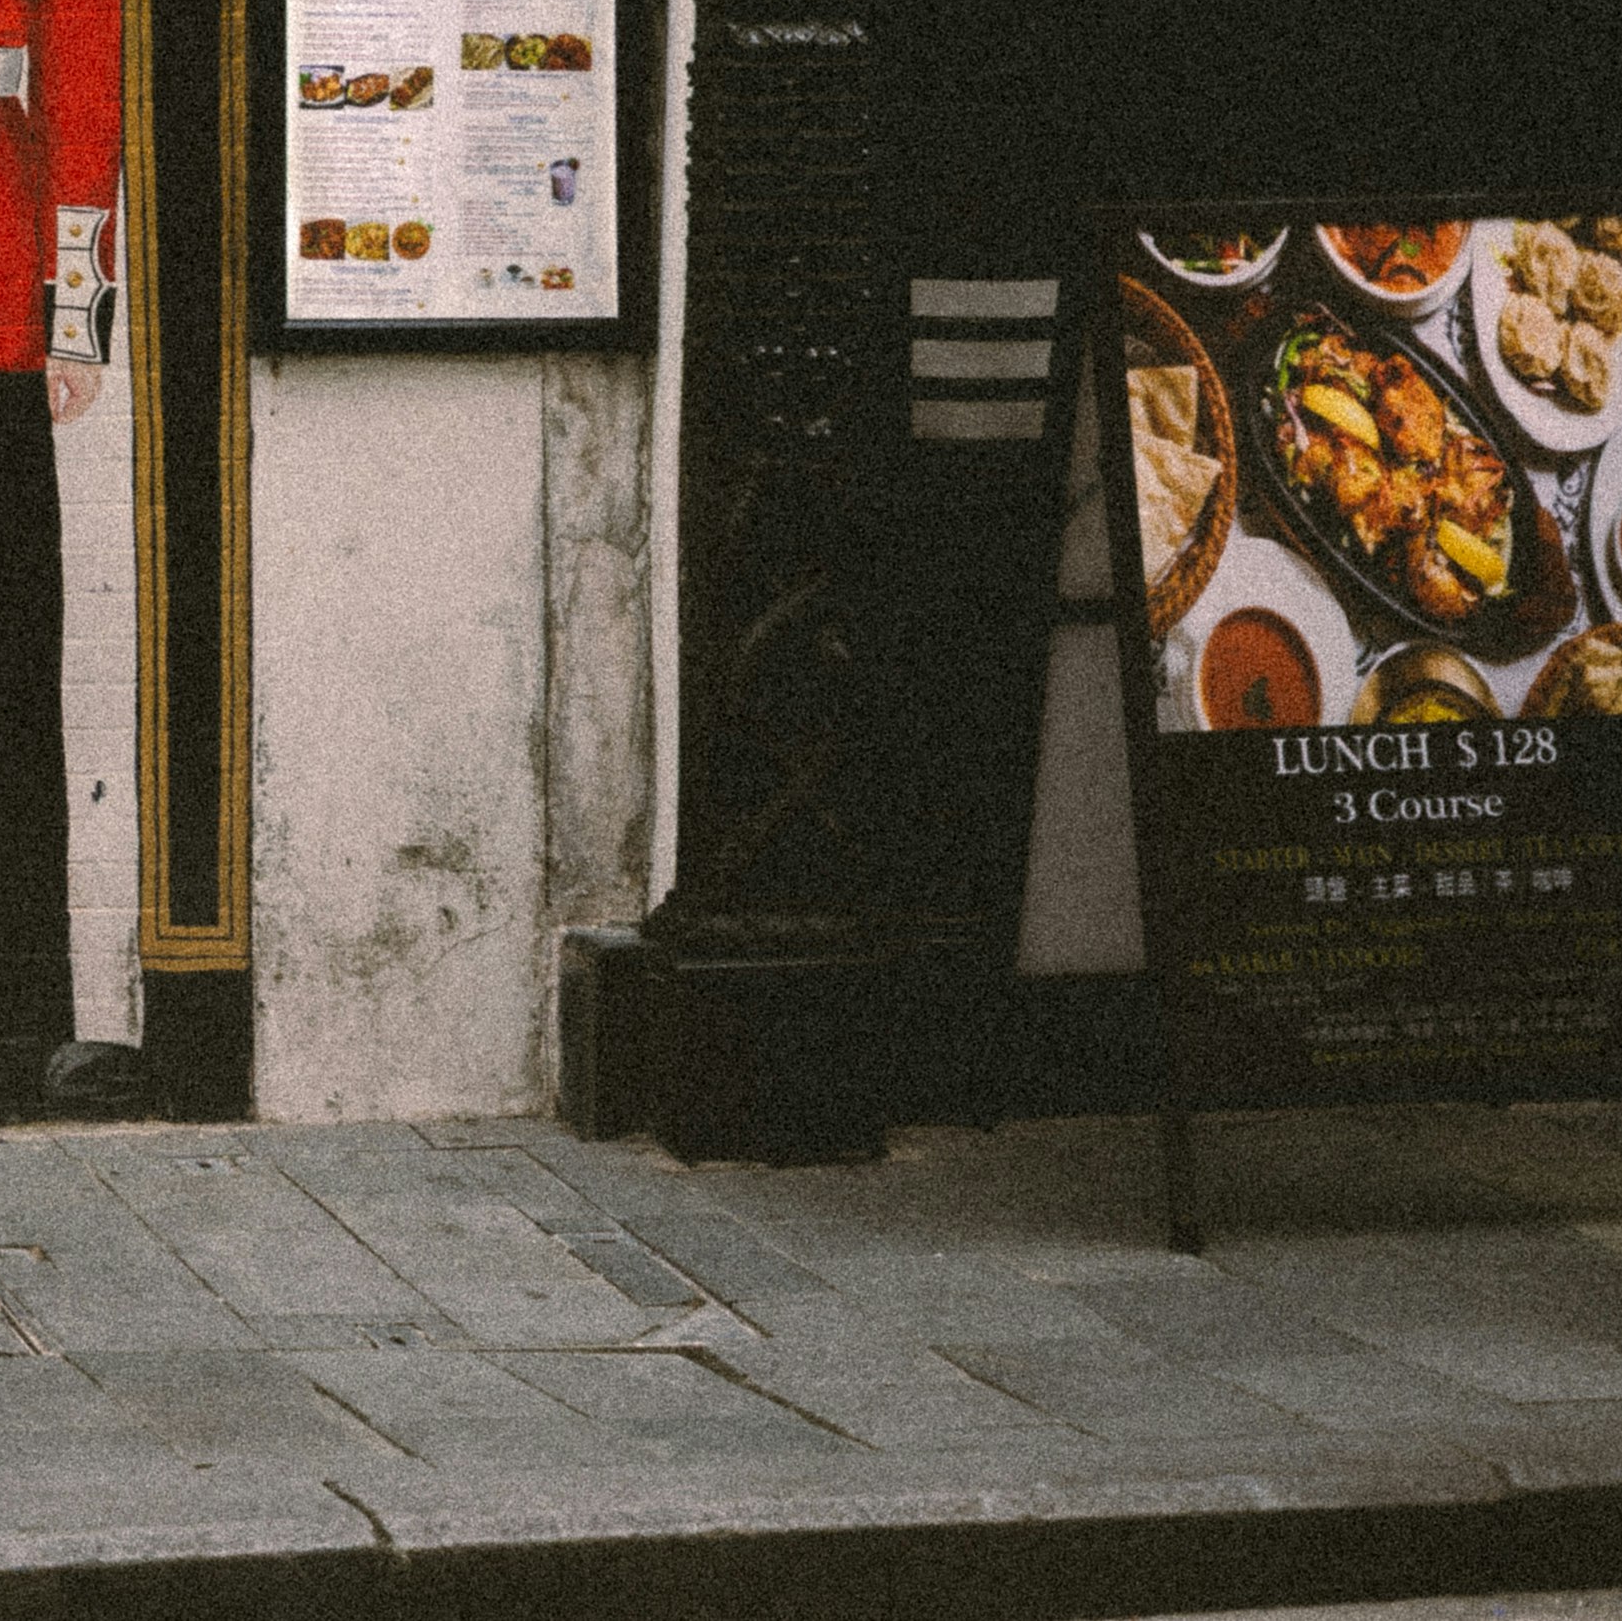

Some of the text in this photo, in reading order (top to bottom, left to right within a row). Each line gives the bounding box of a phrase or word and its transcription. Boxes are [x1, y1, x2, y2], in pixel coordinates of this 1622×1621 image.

[1273, 732, 1430, 776] LUNCH
[1493, 727, 1559, 767] 128
[1334, 788, 1504, 824] 3 Course
